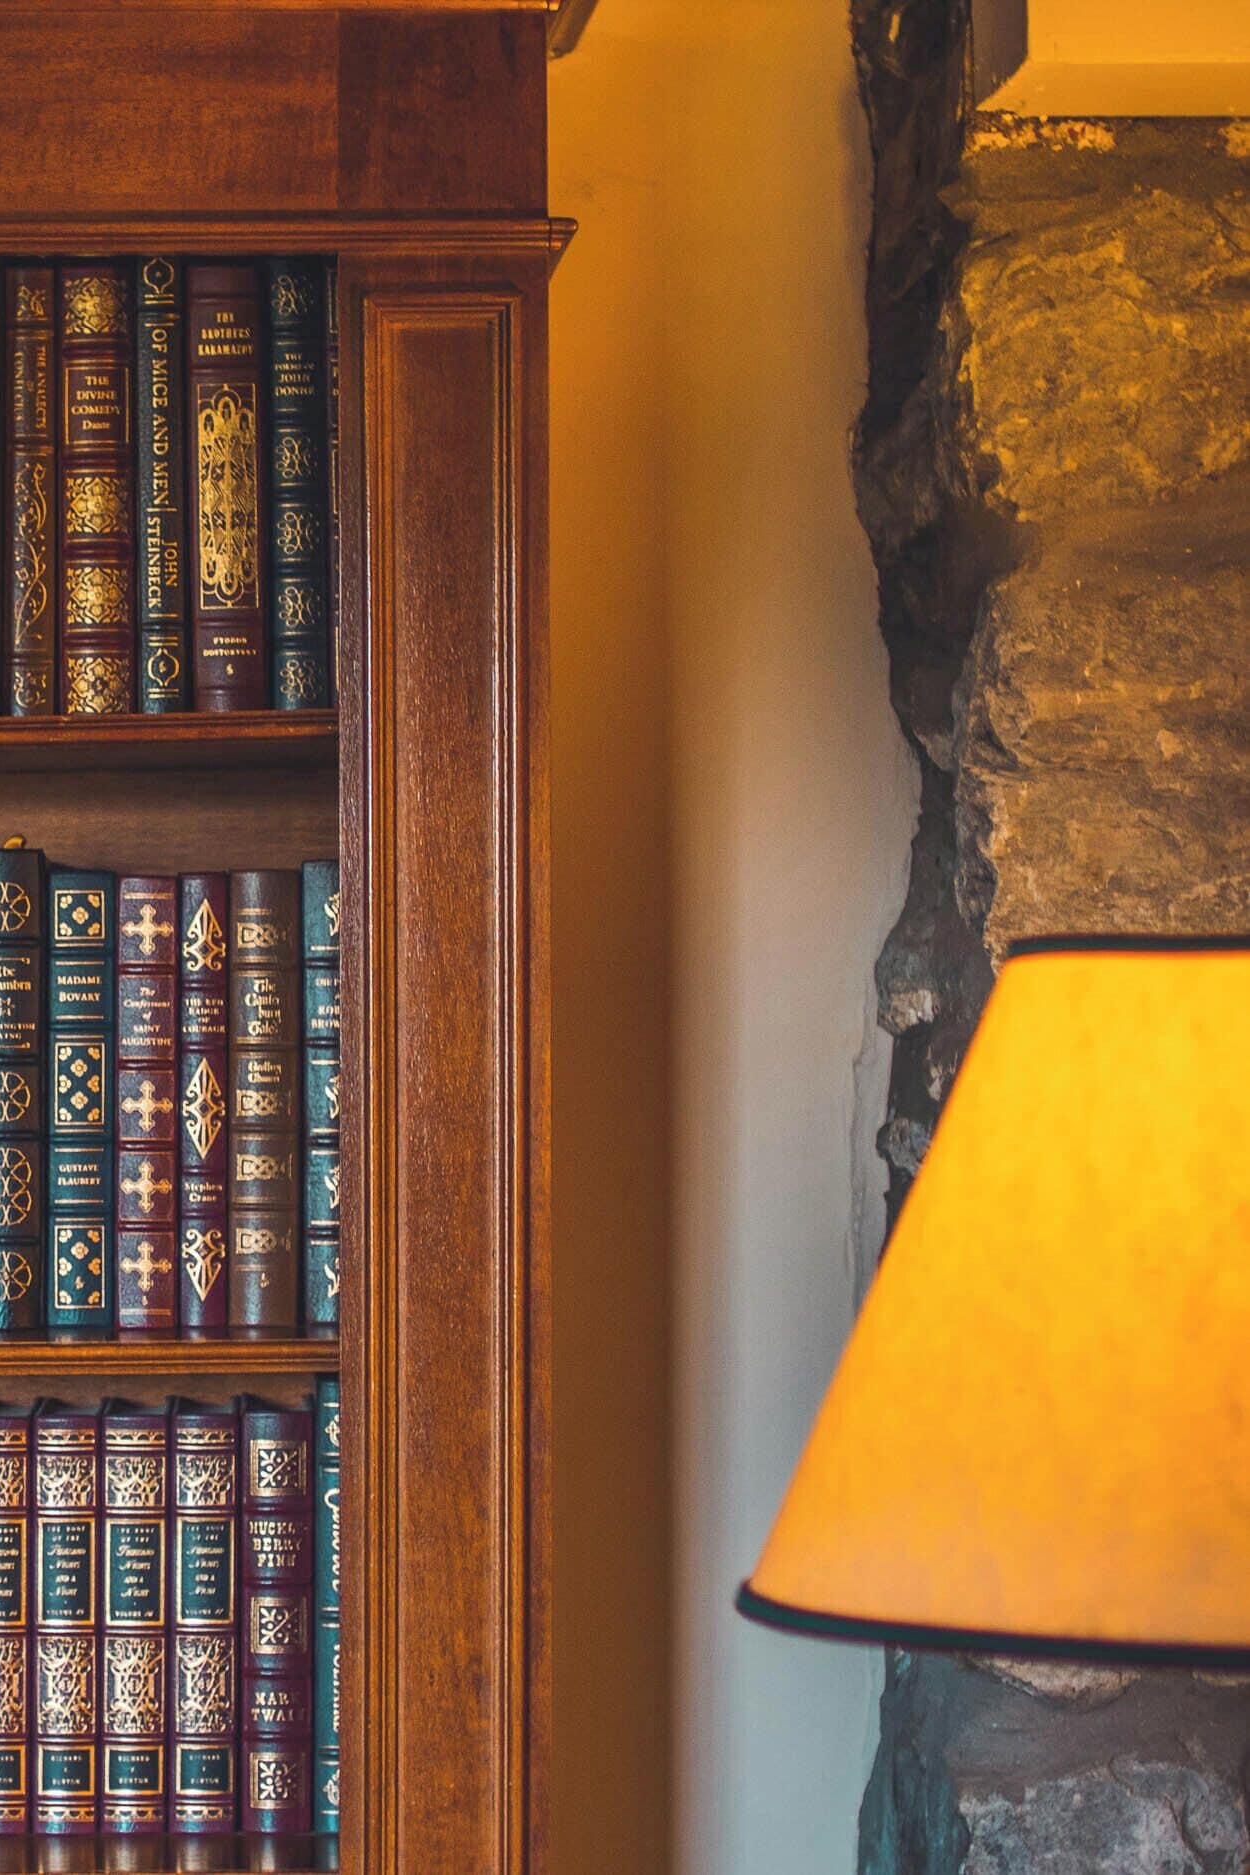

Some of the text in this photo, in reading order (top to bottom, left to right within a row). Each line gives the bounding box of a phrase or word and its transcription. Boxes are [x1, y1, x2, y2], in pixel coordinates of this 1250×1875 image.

[202, 328, 251, 340] BROTHERS
[84, 375, 110, 385] THE
[76, 390, 117, 401] DIVINE
[71, 405, 121, 415] COMEDY
[151, 328, 169, 505] OF MICE AND MEN
[147, 516, 162, 609] STEINBECK
[162, 540, 178, 588] JOHN
[57, 975, 102, 985] MADAME
[253, 977, 276, 993] The
[59, 991, 101, 1002] BOVARY
[133, 1024, 161, 1033] SAINT
[121, 1037, 172, 1046] AUGUSTINE
[58, 1164, 99, 1173] GUSTAVE
[58, 1177, 102, 1186] FLAUBERT
[184, 1183, 223, 1193] Stephen
[189, 1193, 218, 1202] Crane
